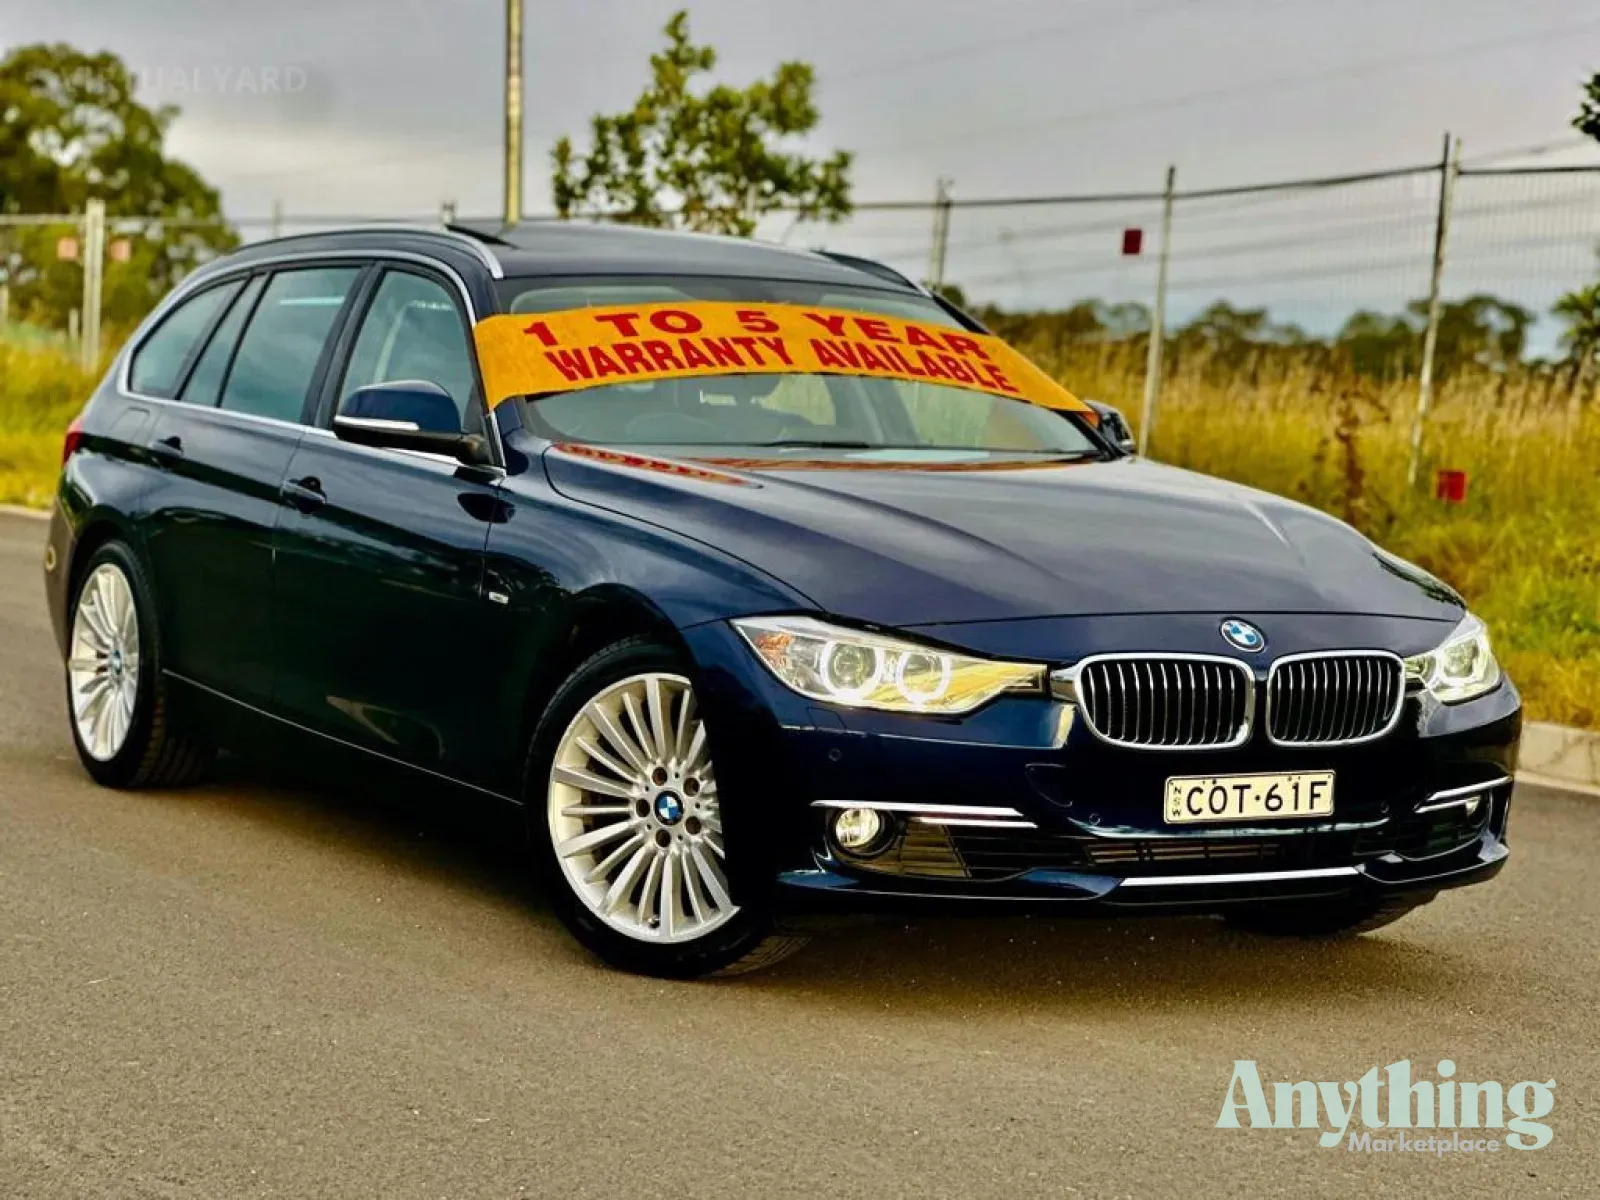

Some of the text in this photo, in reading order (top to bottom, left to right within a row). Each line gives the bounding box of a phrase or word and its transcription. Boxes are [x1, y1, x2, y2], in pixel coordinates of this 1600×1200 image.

[523, 310, 990, 361] 1 TO 5 YEAR
[543, 336, 1020, 393] WARRANTY AVAILABLE
